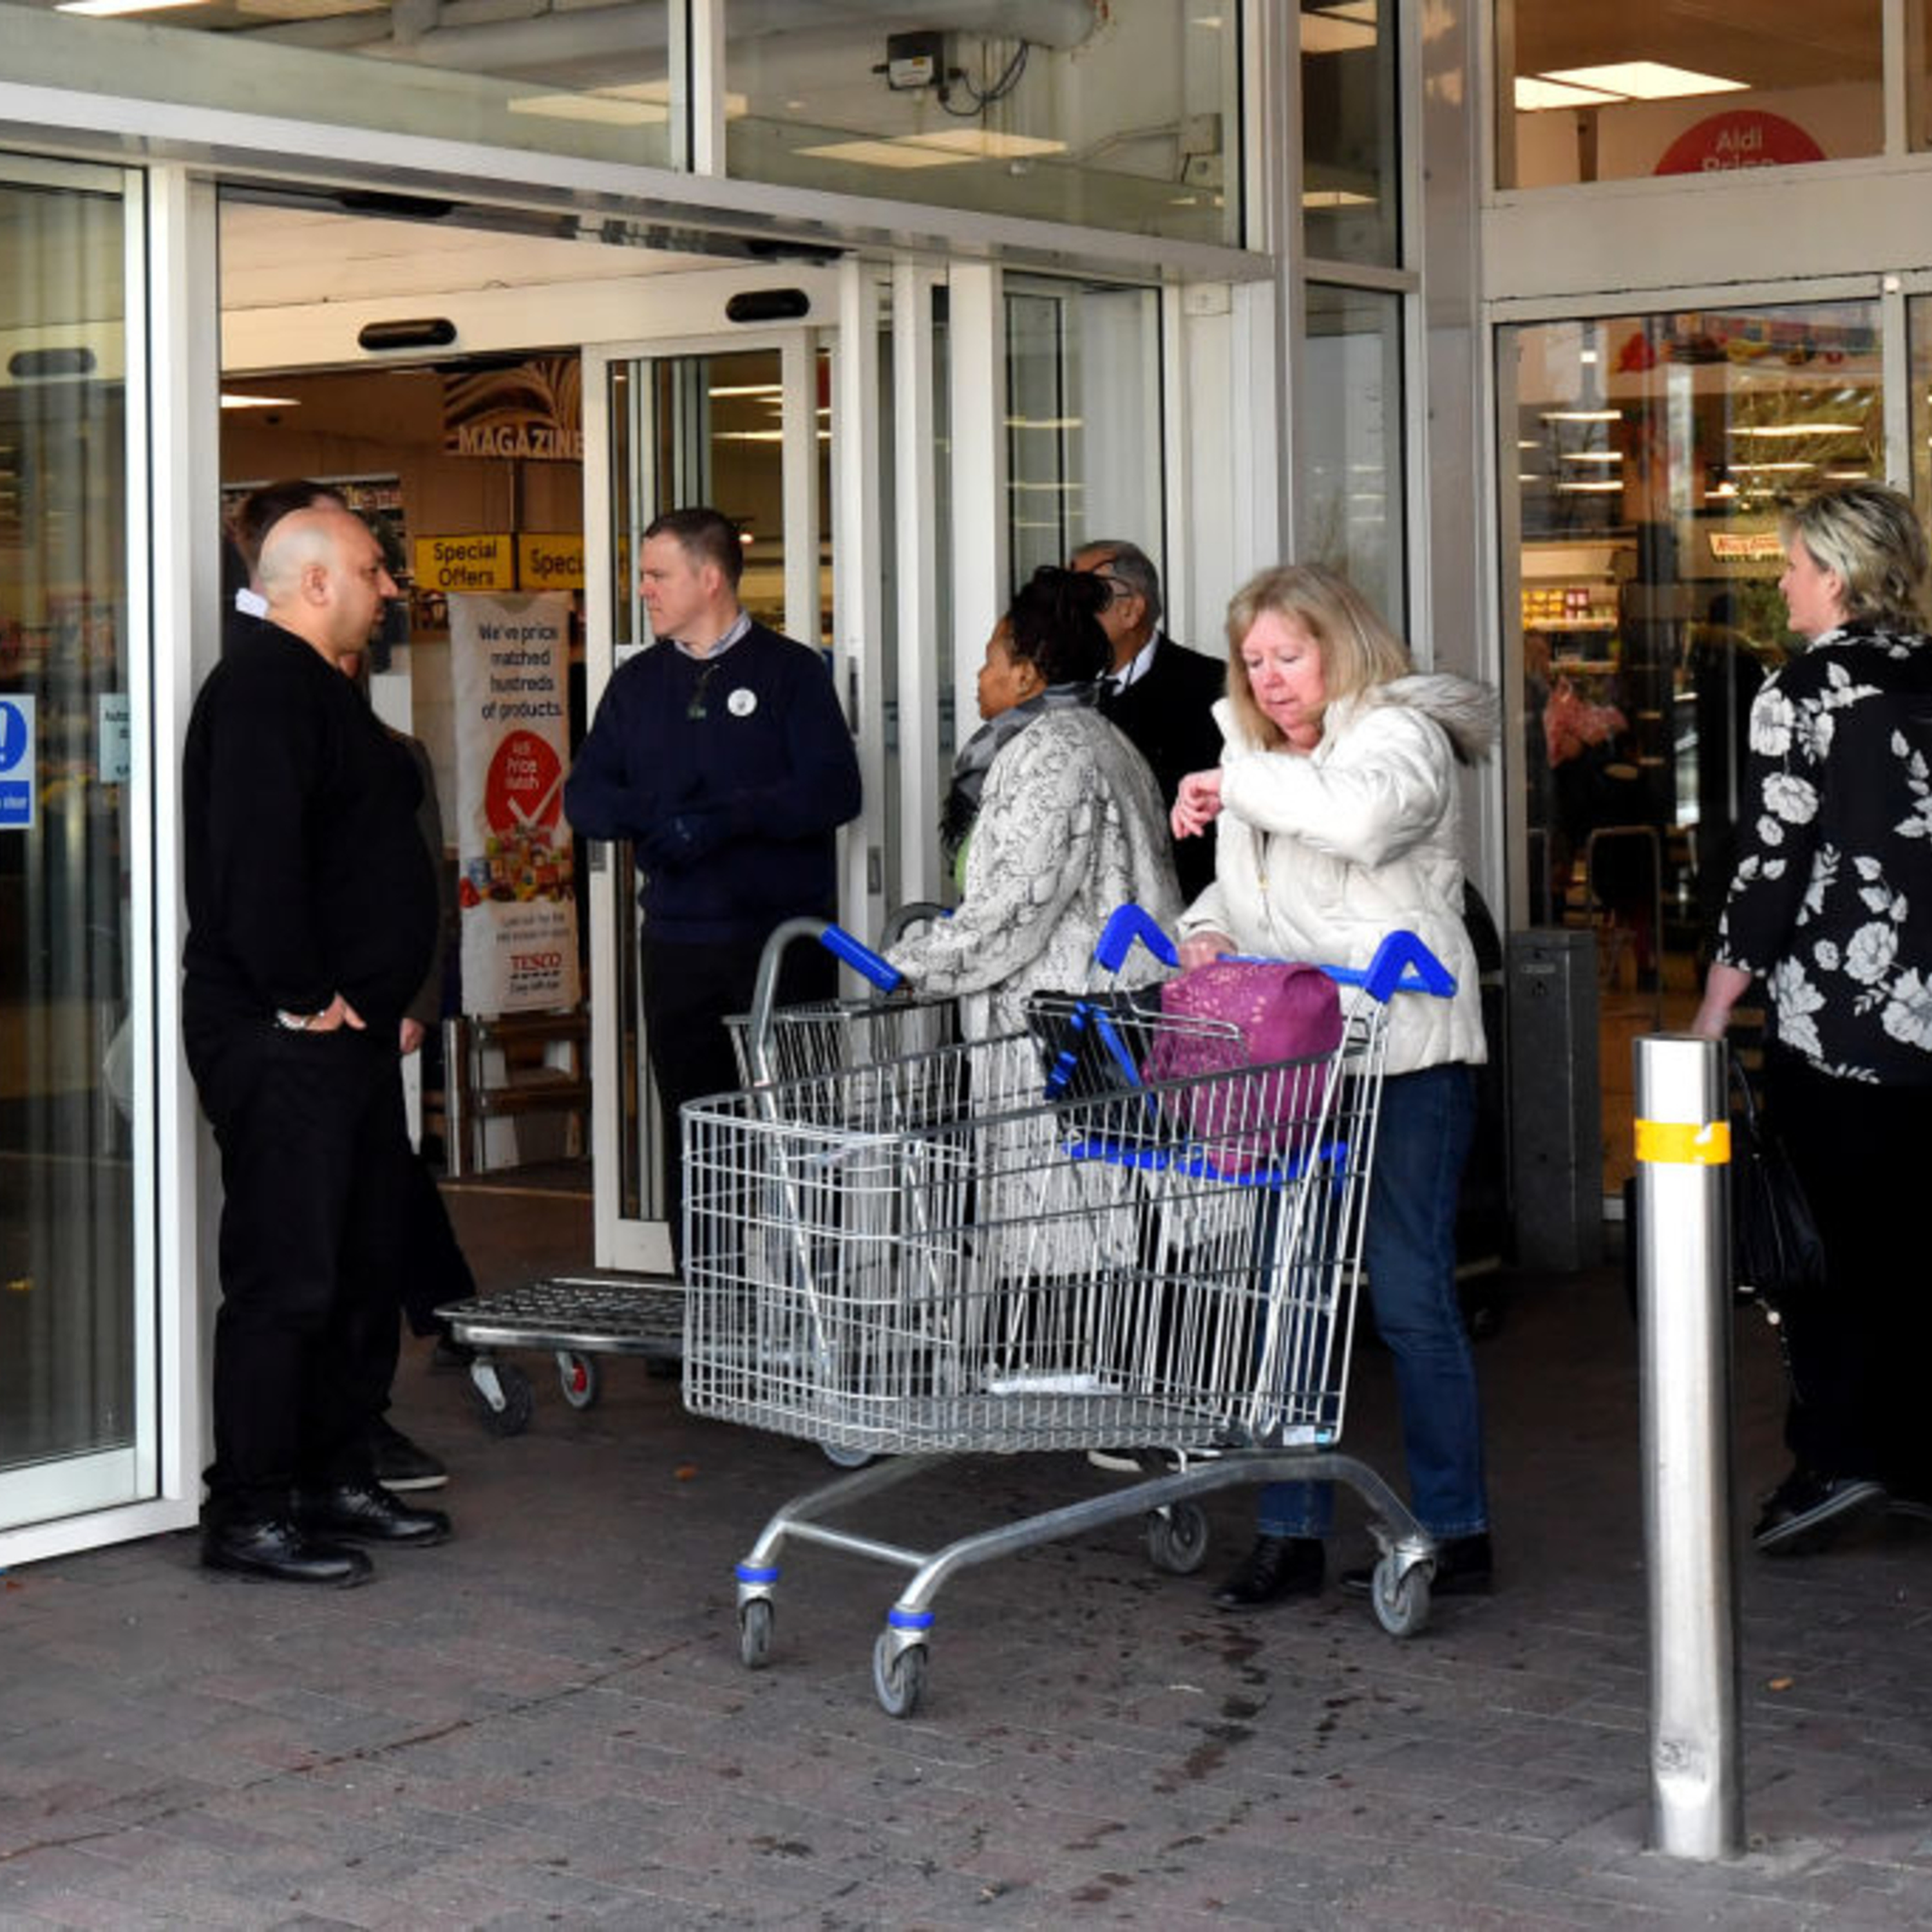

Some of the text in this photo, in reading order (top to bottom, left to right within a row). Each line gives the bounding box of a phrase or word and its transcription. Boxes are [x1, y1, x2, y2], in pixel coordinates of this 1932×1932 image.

[1715, 126, 1763, 153] Aldi
[433, 540, 497, 564] Special
[439, 565, 495, 587] Offers
[479, 622, 559, 645] We've price
[490, 650, 551, 666] matched
[490, 674, 554, 692] hundreds
[482, 701, 497, 720] of
[509, 952, 562, 970] TESCO
